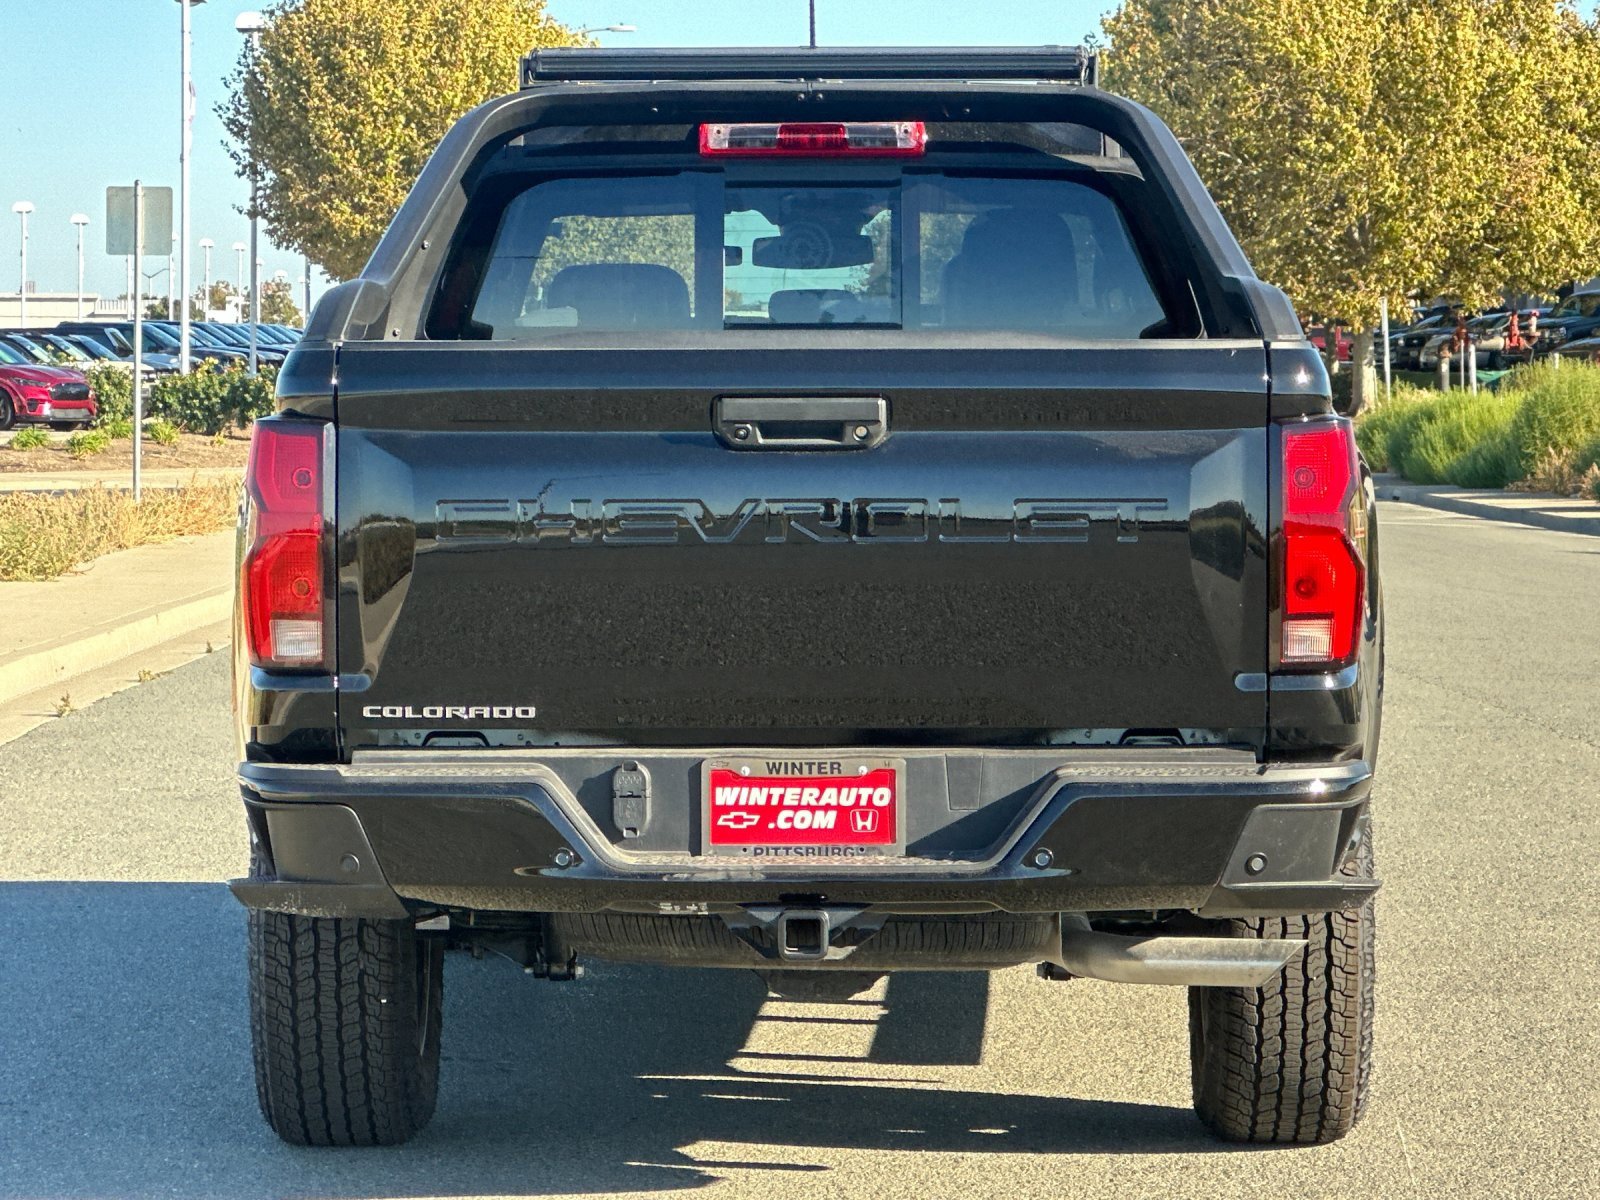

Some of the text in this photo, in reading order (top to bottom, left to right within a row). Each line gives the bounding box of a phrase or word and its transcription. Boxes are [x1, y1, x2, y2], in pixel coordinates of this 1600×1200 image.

[435, 498, 1167, 543] CHEVROLET
[362, 705, 536, 719] COLORADO
[766, 761, 842, 775] WINTER
[715, 786, 891, 807] WINTERAUTO
[768, 810, 837, 829] .COM
[753, 847, 855, 856] PITTSBURG
